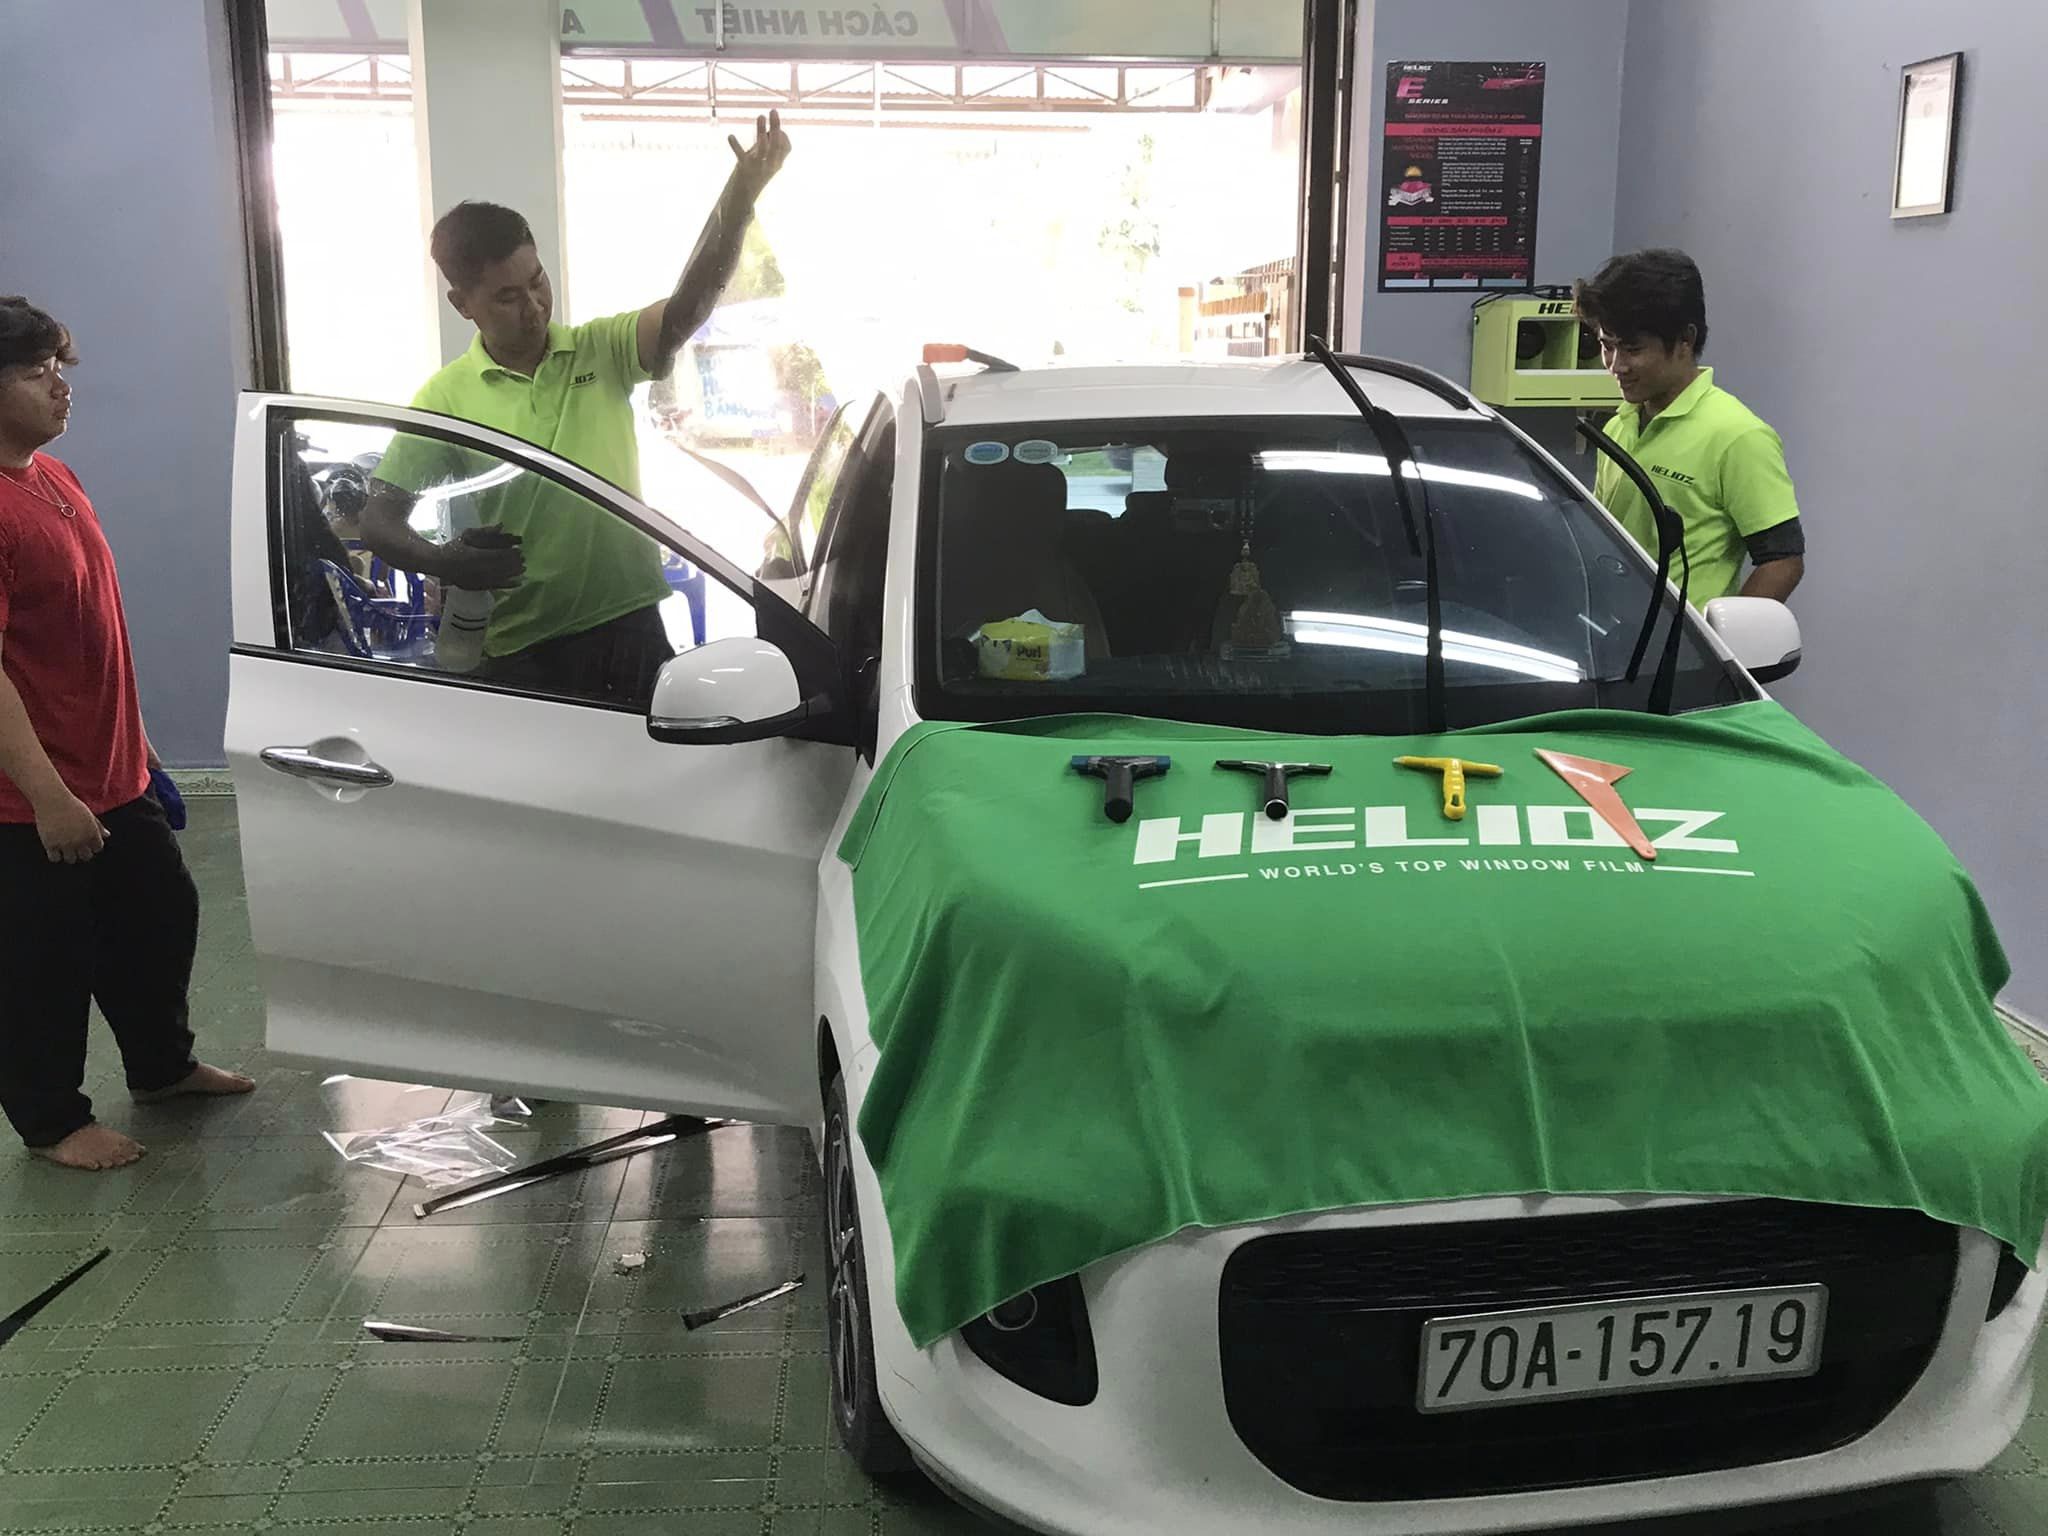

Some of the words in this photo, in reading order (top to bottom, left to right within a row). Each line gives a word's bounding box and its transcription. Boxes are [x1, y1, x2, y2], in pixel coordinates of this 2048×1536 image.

[1396, 75, 1426, 98] E
[1538, 302, 1575, 314] HE
[1651, 464, 1696, 485] HELIOZ
[1133, 805, 1739, 865] HELIOZ
[1259, 861, 1385, 880] WORLD'S
[1395, 860, 1448, 873] TOP
[1459, 859, 1571, 871] WINDOW
[1583, 860, 1645, 873] FILM
[1437, 1298, 1807, 1398] 70A-157.19
